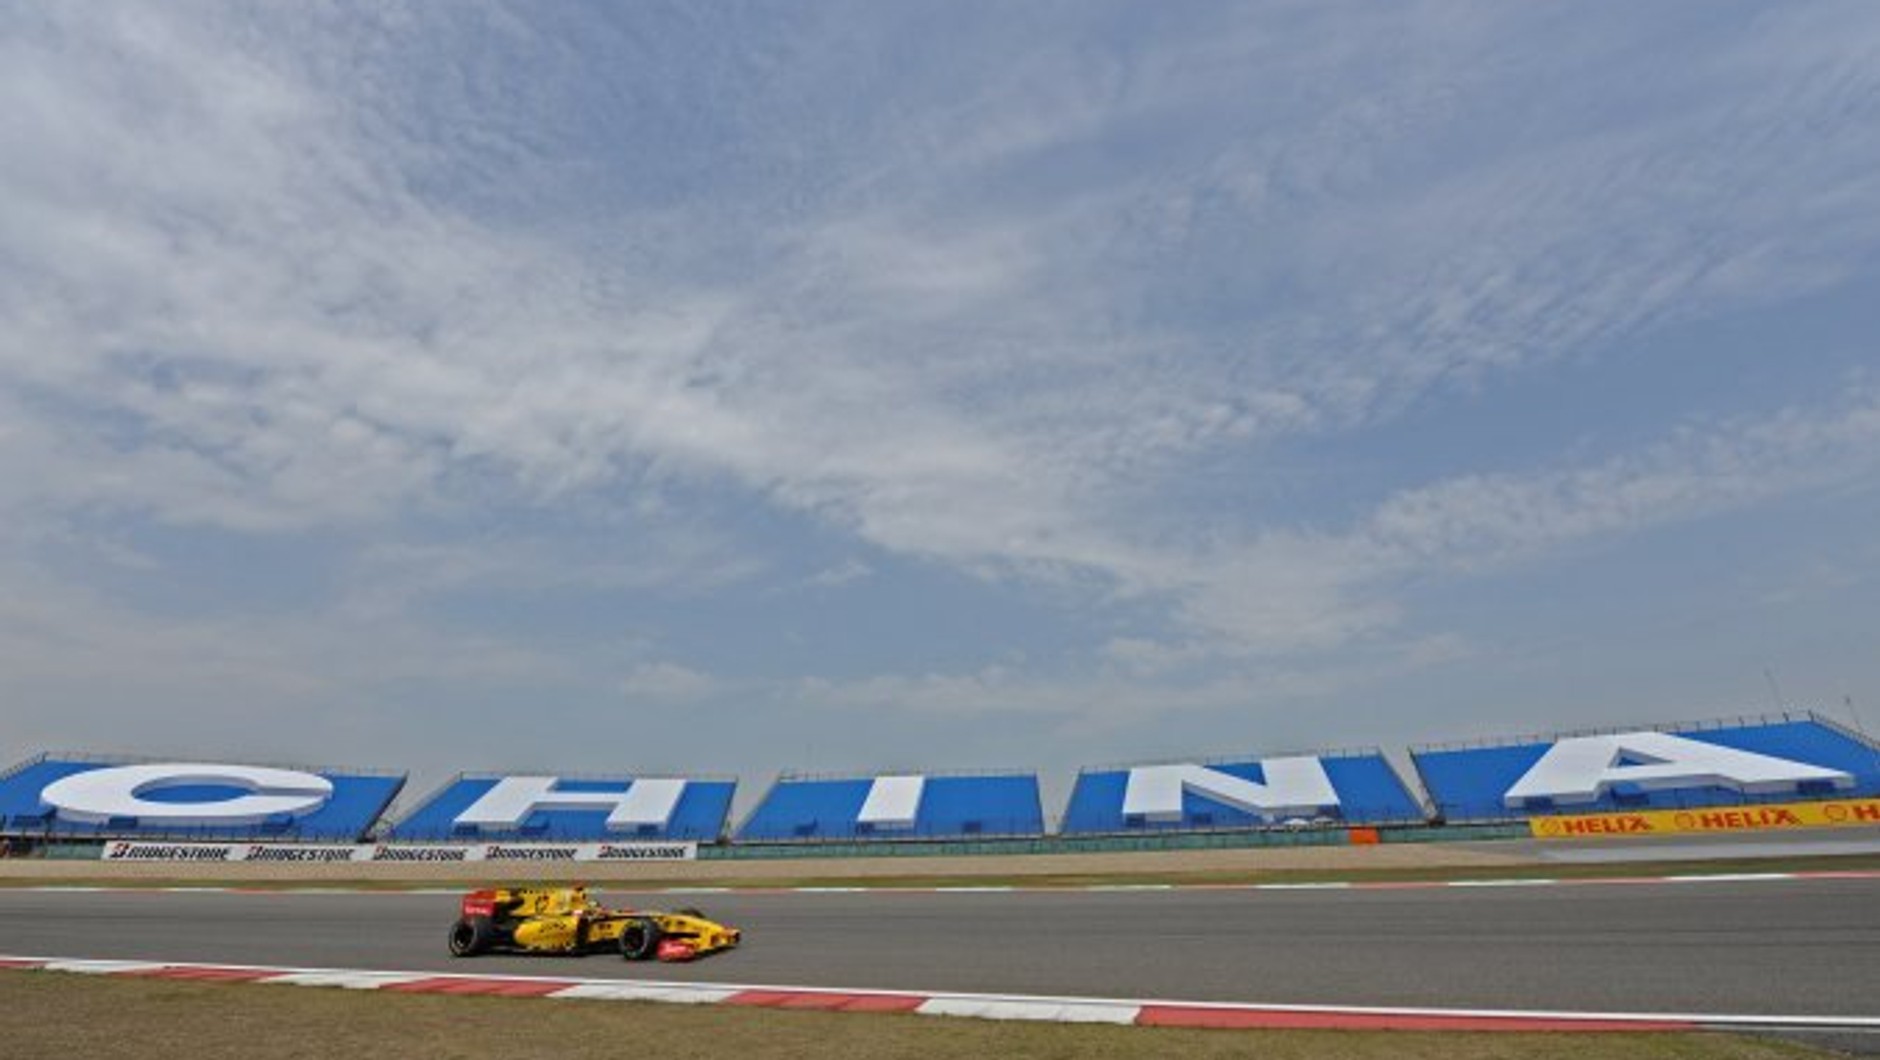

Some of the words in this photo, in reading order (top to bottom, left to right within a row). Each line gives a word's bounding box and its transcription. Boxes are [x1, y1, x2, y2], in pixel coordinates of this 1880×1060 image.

[1563, 814, 1653, 833] HELIX
[1701, 808, 1803, 828] HELIX
[110, 842, 230, 859] BRIDGESTONE
[244, 845, 355, 862] BRIDGESTONE
